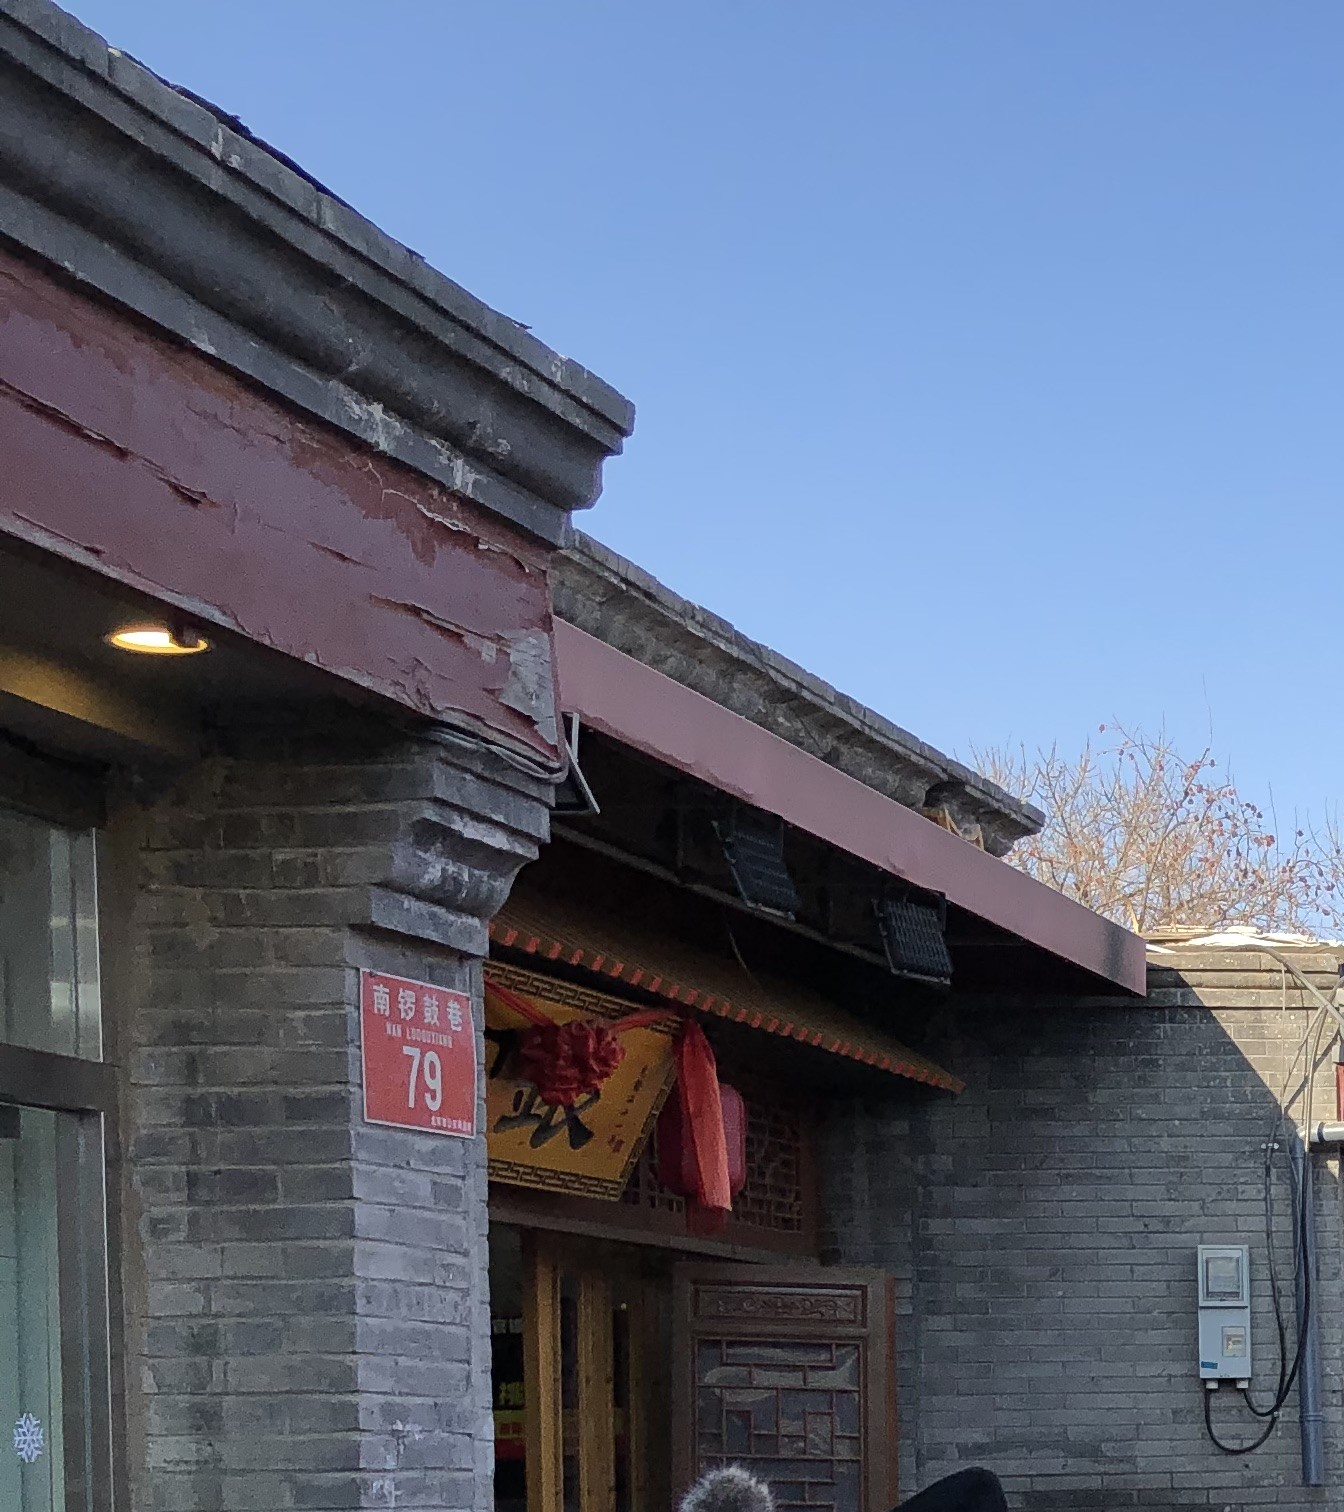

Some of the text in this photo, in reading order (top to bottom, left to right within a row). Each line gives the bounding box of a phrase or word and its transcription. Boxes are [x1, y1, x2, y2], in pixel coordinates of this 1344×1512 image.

[372, 983, 463, 1032] 南锣鼓巷
[402, 1045, 442, 1112] 79
